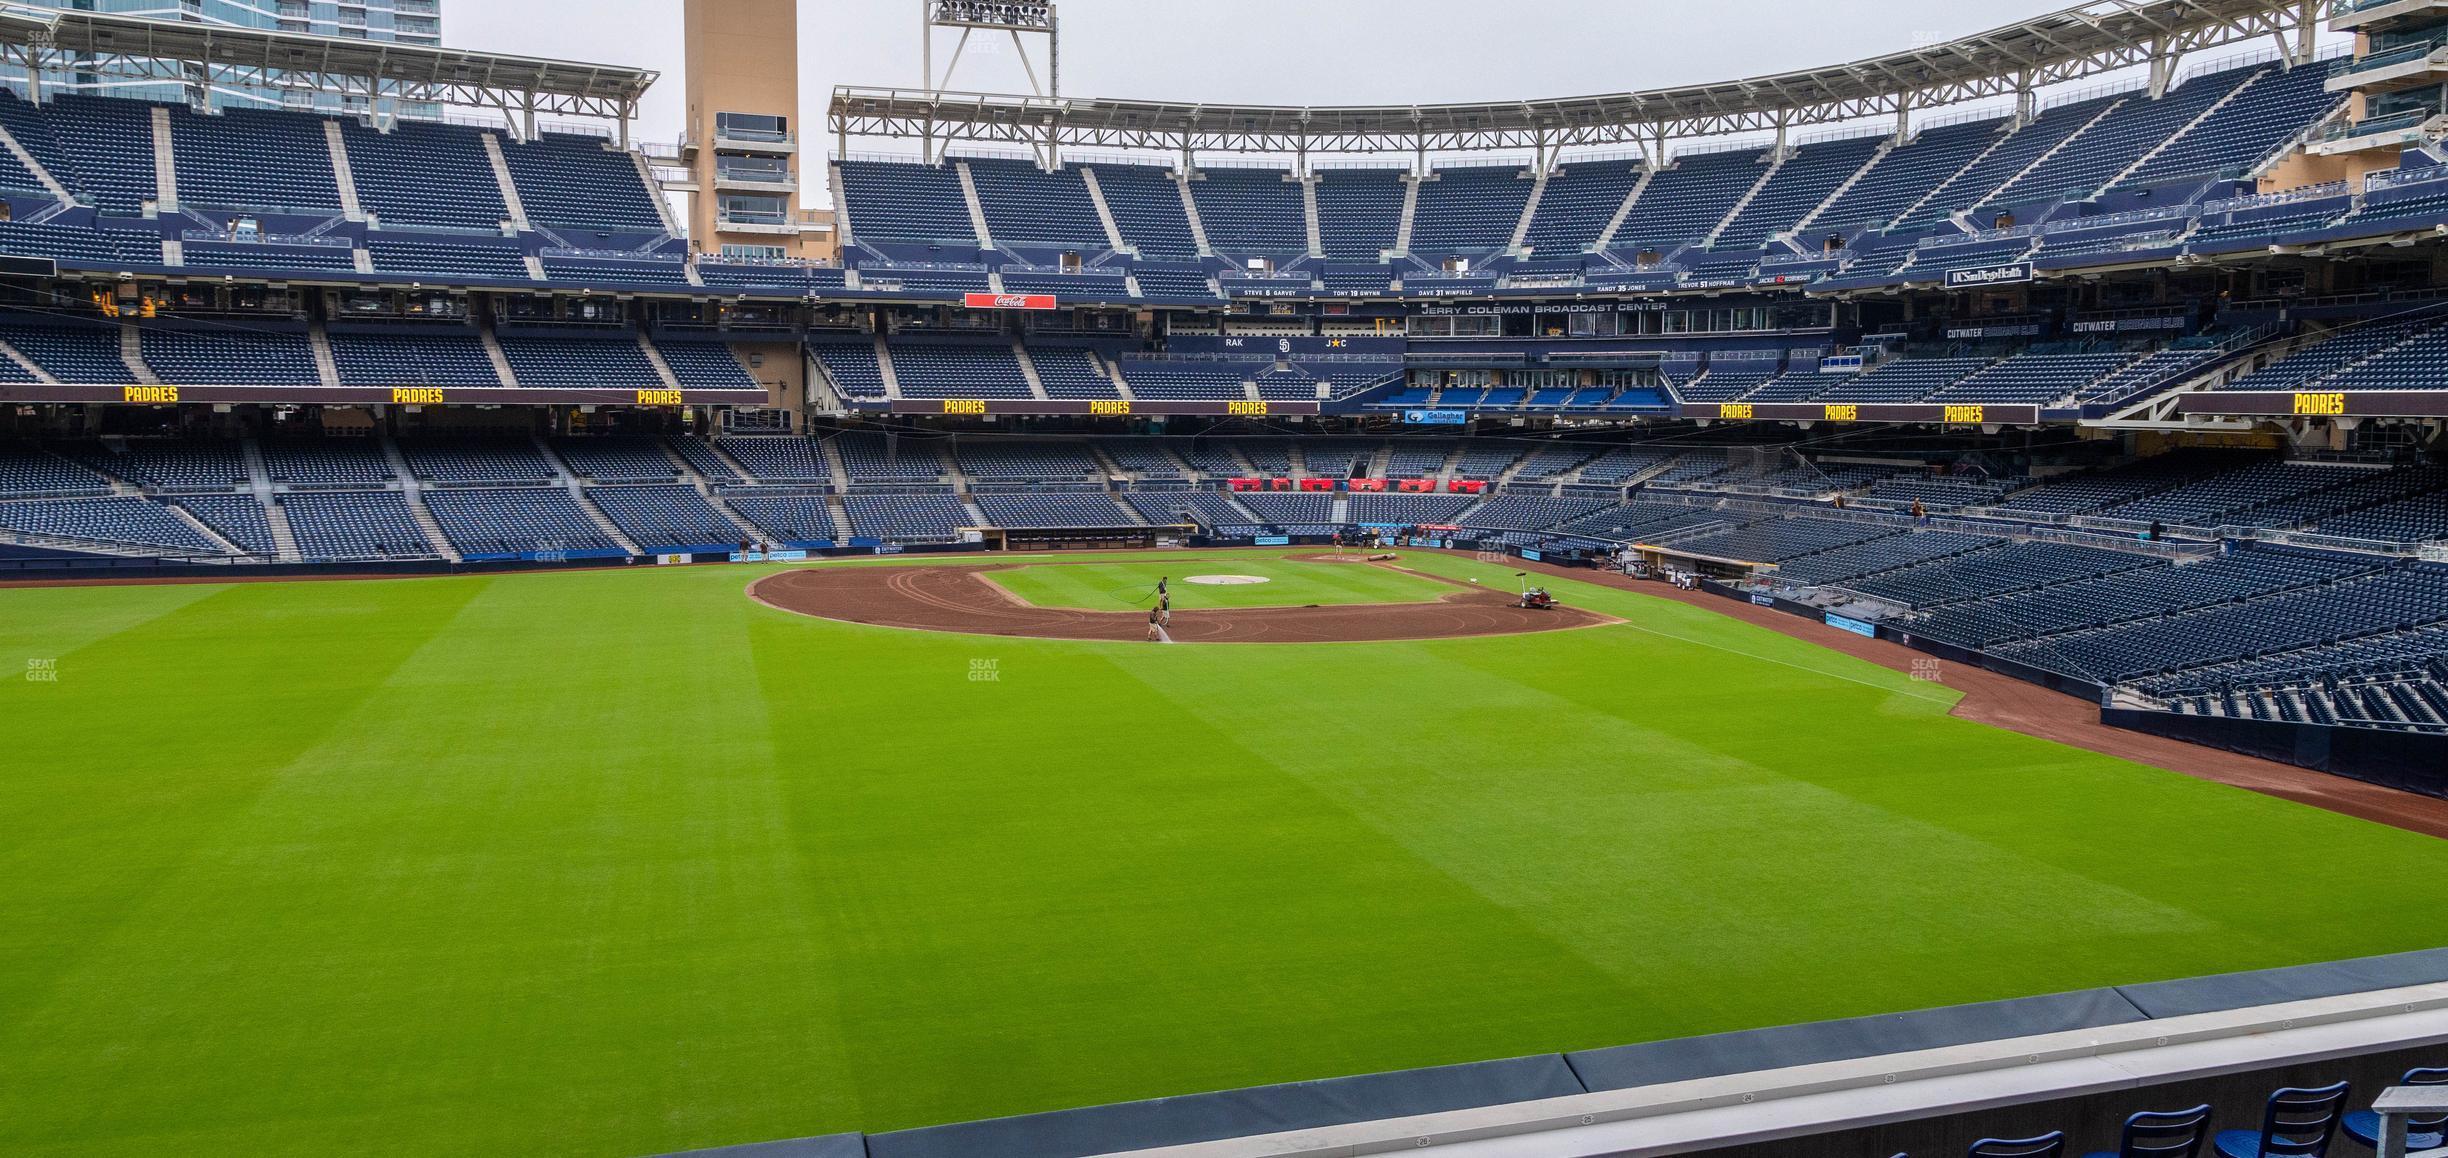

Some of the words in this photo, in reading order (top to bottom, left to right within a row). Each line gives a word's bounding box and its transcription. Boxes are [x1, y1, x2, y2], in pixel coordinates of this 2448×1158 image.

[994, 295, 1026, 307] Coca-Cola
[1422, 305, 1462, 314] JERRY
[1467, 306, 1529, 314] COLEMAN
[1535, 304, 1613, 313] BROADCAST
[1618, 303, 1667, 311] CENTER
[1947, 327, 1983, 338] CUTWATER
[2073, 320, 2116, 332] CUTWATER
[124, 386, 178, 402] PADRES
[393, 388, 443, 403] PADRES
[638, 390, 682, 404] PADRES
[944, 400, 985, 413] PADRES
[1091, 401, 1130, 414] PADRES
[1229, 402, 1267, 414] PADRES
[2294, 393, 2344, 414] PADRES
[1427, 412, 1463, 421] Gallagher
[1720, 404, 1752, 418] PADRES
[1825, 405, 1856, 420] PADRES
[1944, 406, 1983, 422] PADRES
